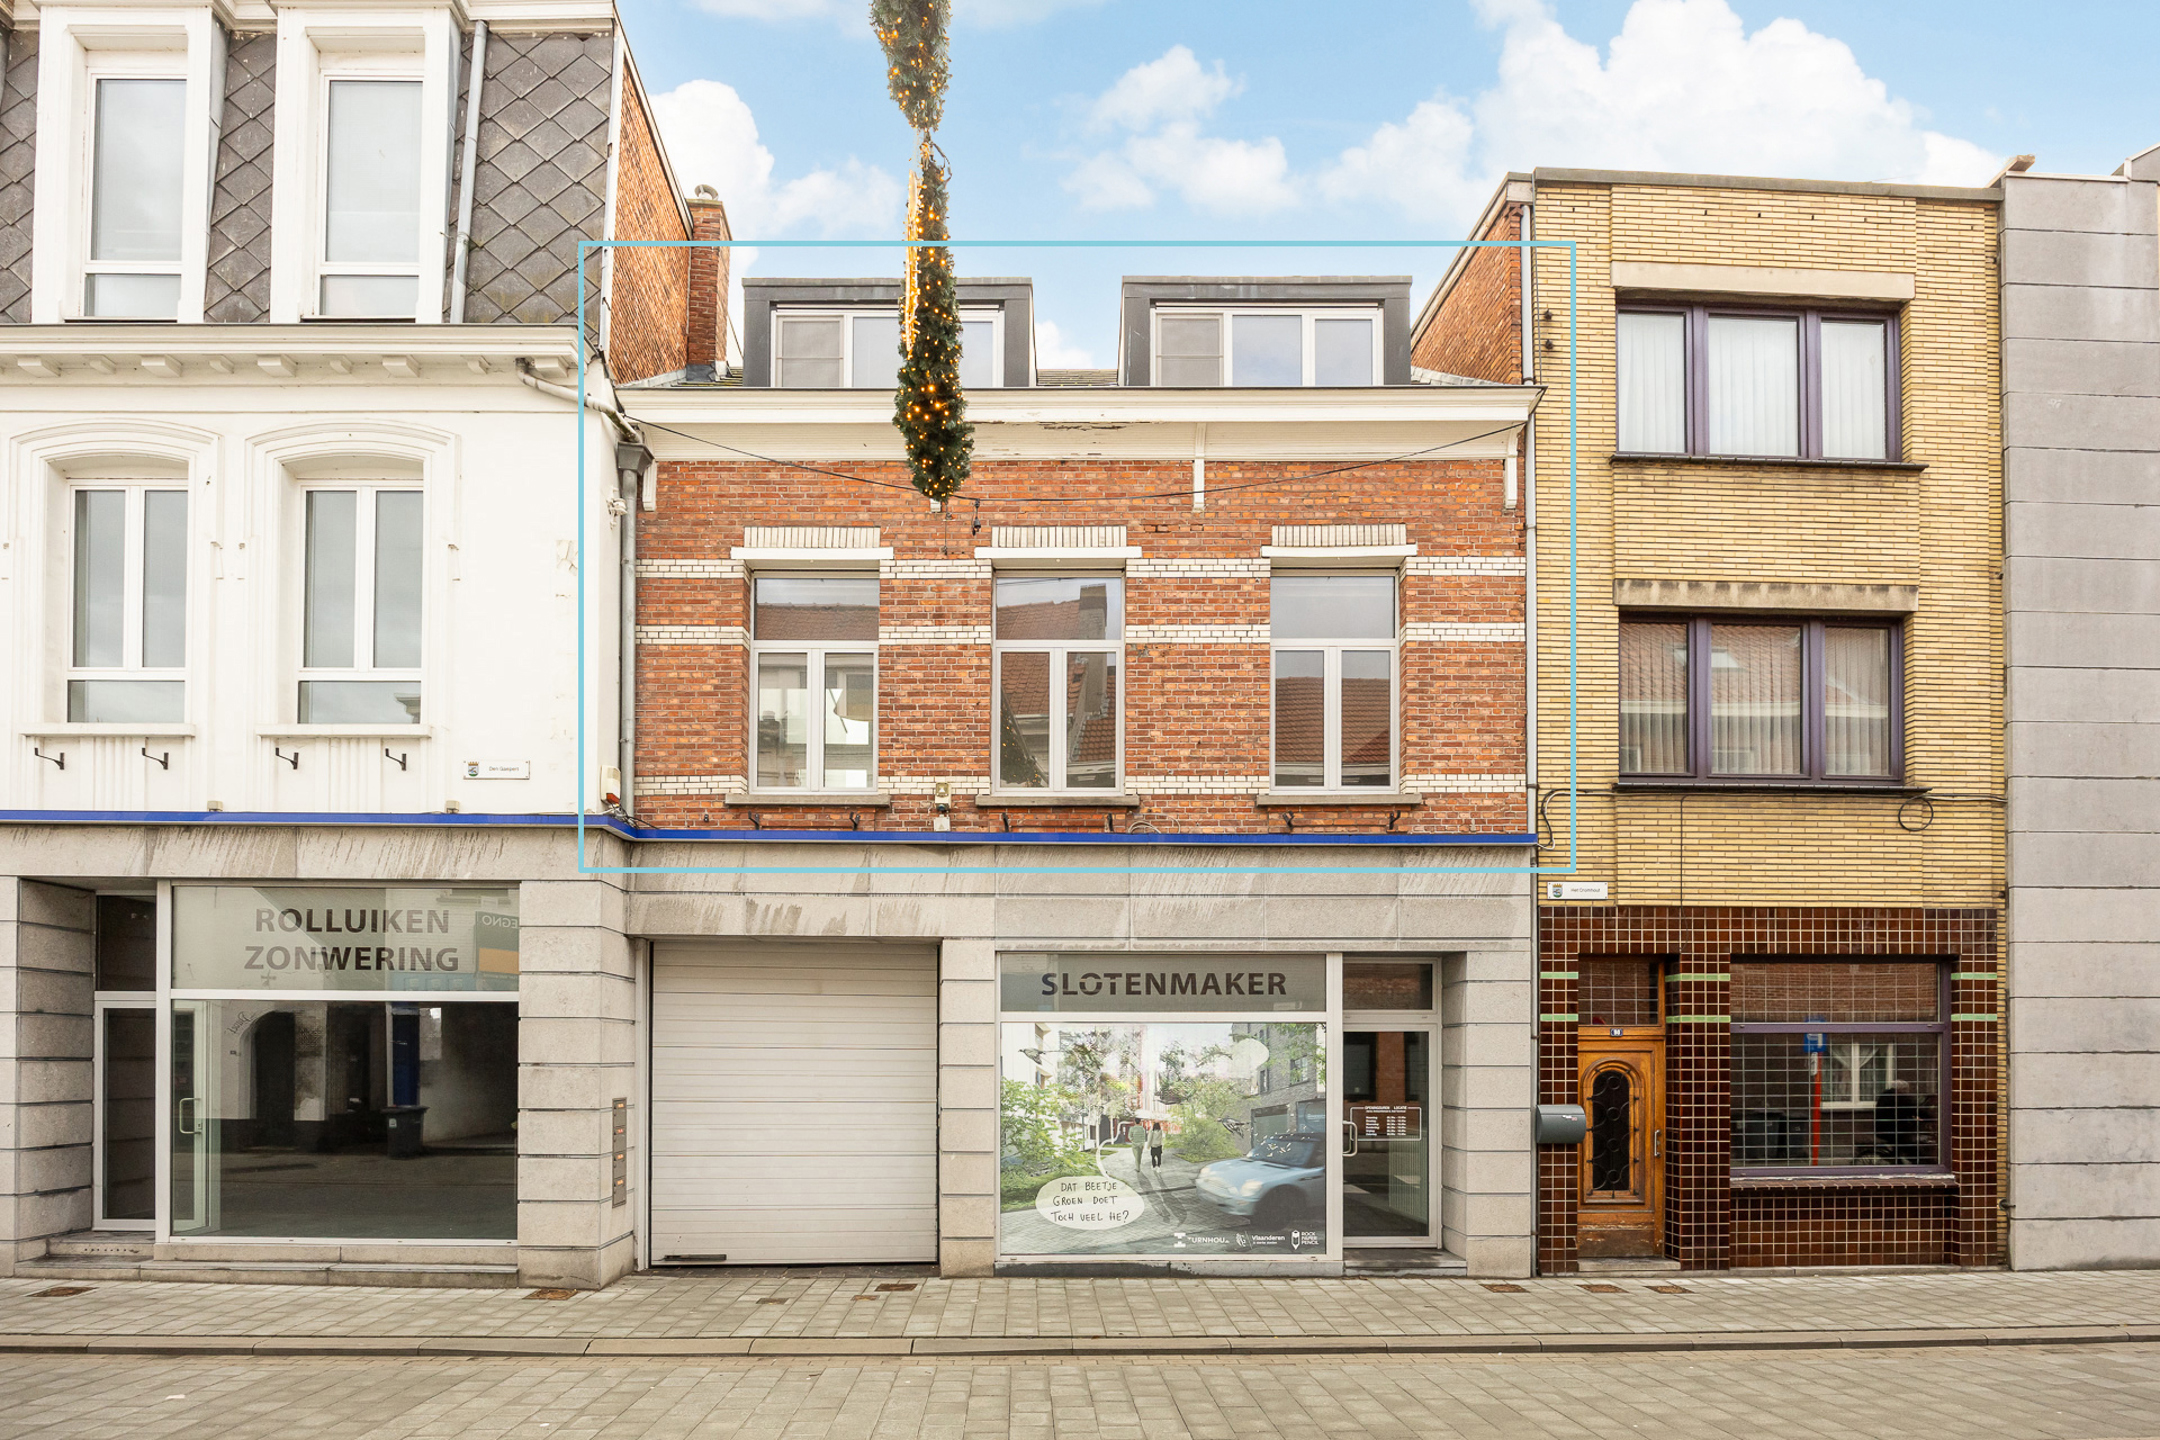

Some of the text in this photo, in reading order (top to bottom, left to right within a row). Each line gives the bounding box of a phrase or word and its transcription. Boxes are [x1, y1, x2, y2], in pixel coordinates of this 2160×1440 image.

[255, 908, 449, 933] ROLLUIKEN
[244, 945, 459, 971] ZONWERING
[1041, 972, 1287, 995] SLOTENMAKER
[1060, 1181, 1117, 1192] DAT BEETJE
[1053, 1195, 1118, 1206] GROEN DOET
[1080, 1212, 1103, 1222] VEEL
[1109, 1209, 1129, 1223] HE?
